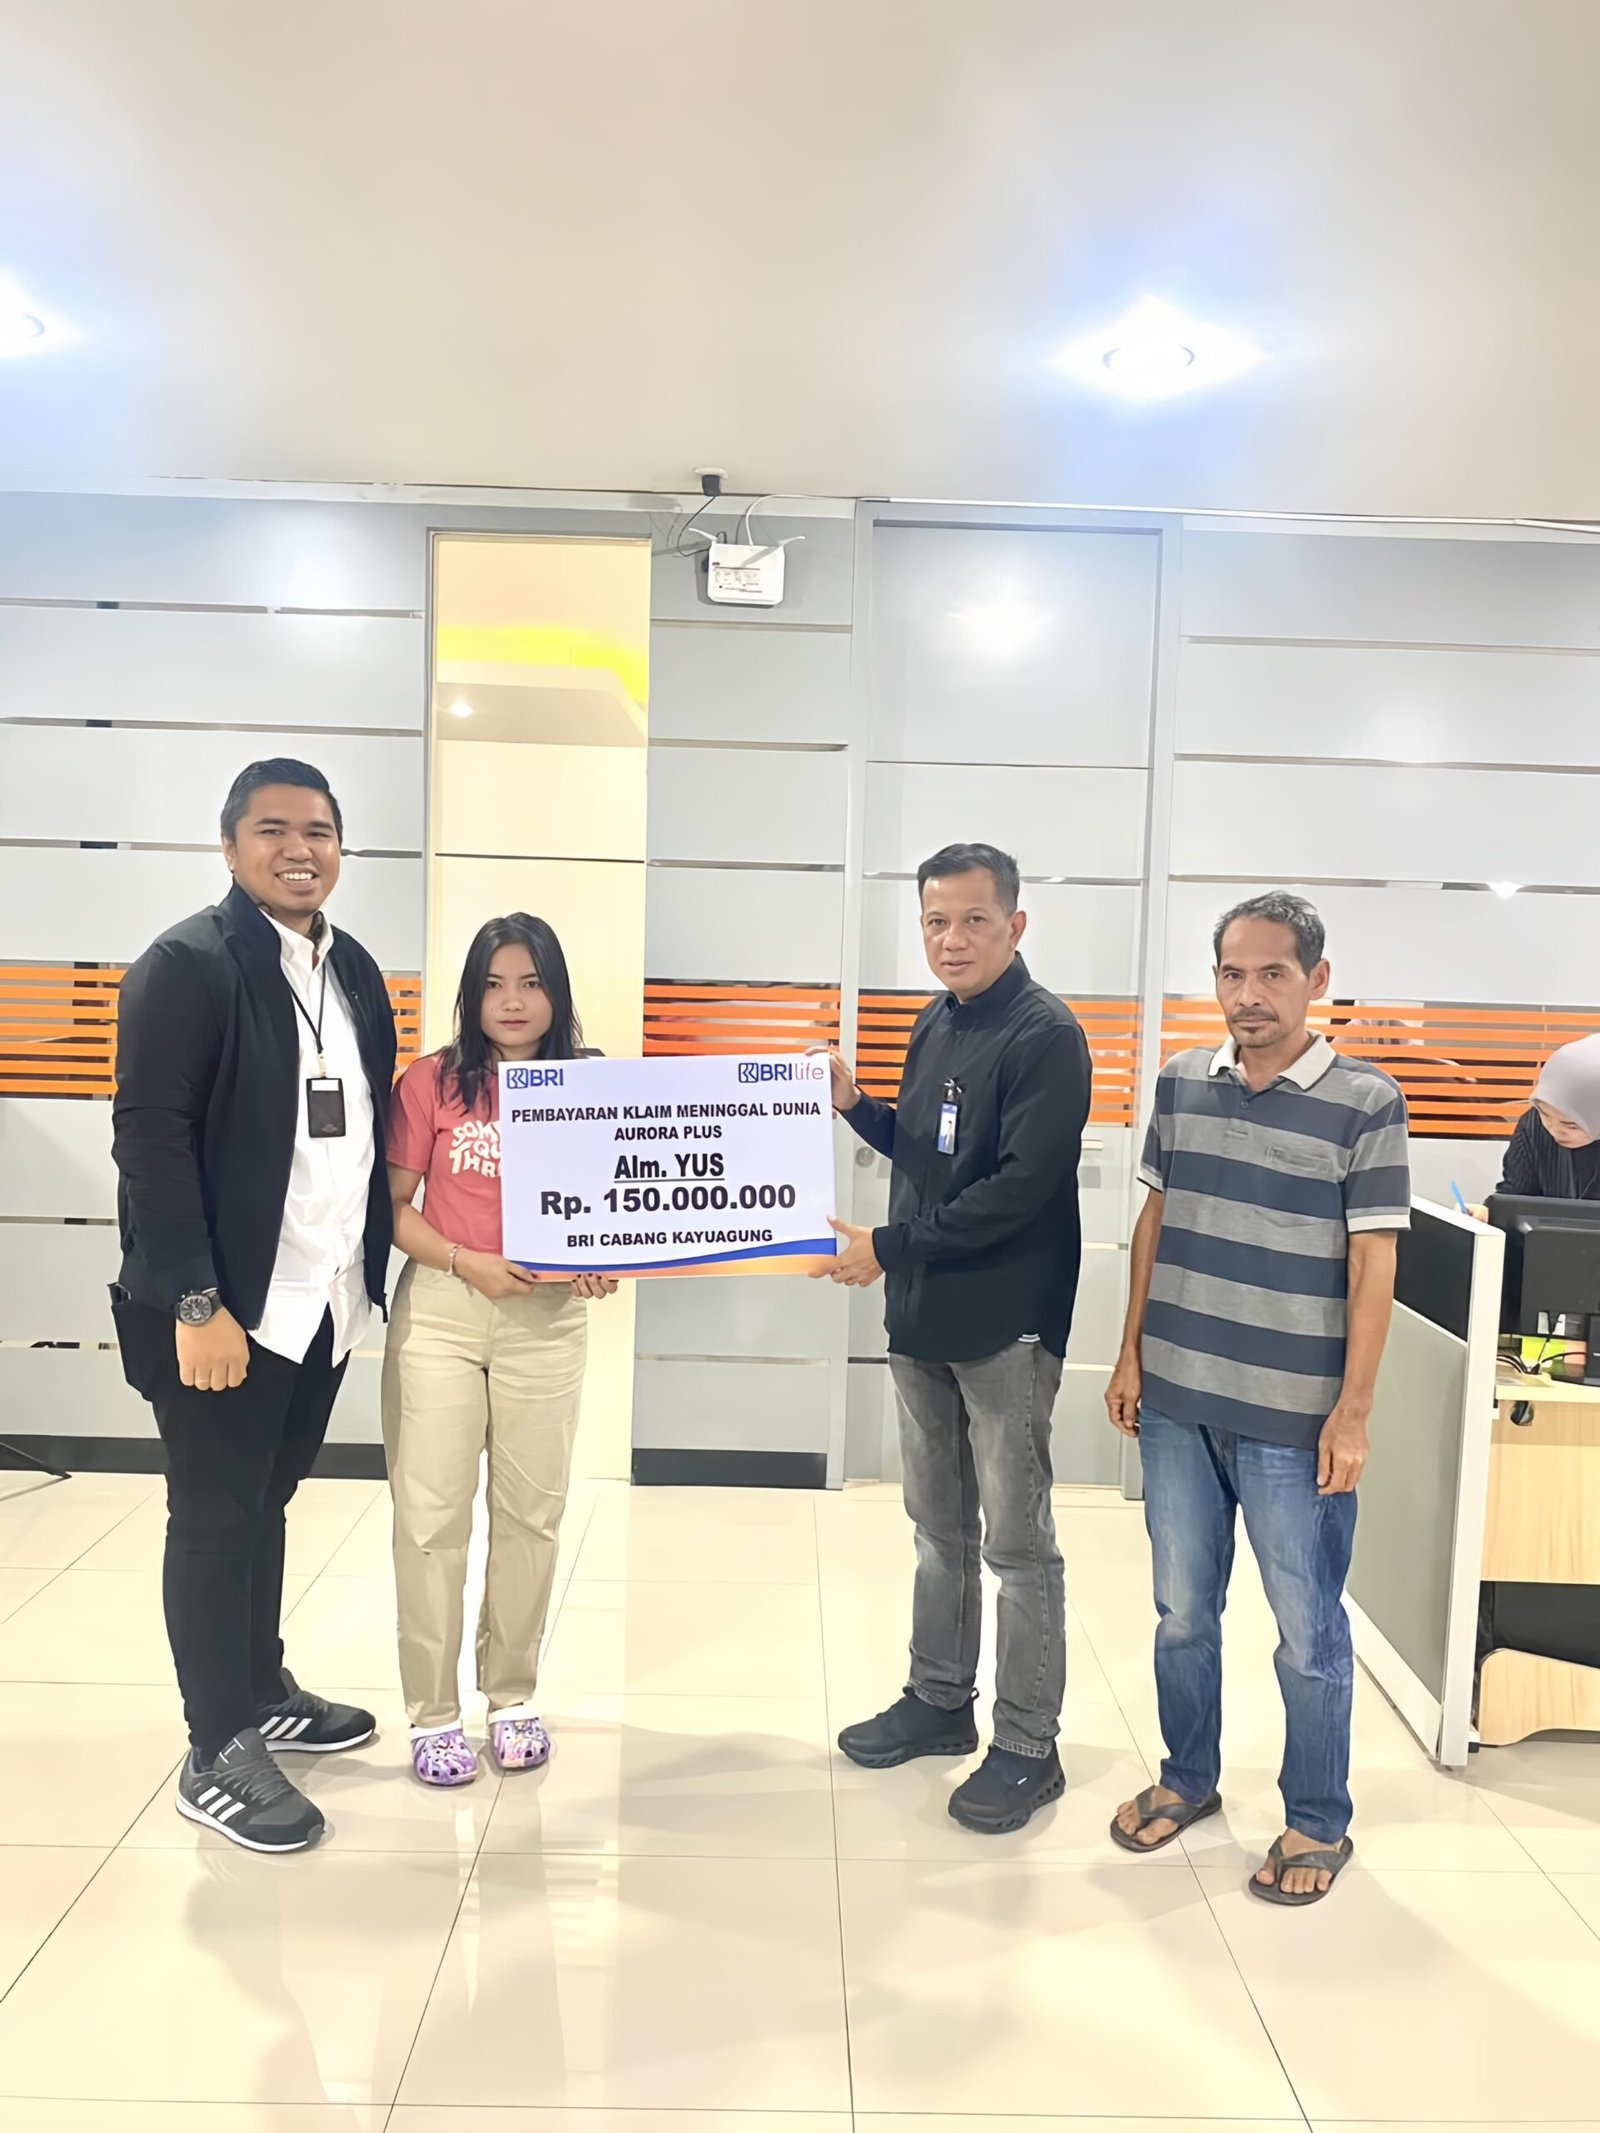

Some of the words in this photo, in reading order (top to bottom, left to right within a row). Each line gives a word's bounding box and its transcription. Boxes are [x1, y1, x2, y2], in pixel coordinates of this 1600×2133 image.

[529, 1068, 564, 1088] BRI
[511, 1106, 618, 1123] PEMBAYARAN
[623, 1105, 672, 1119] KLAIM
[677, 1102, 768, 1117] MENINGGAL
[772, 1101, 821, 1116] DUNIA
[614, 1126, 679, 1141] AURORA
[684, 1125, 722, 1139] PLUS
[449, 1141, 500, 1178] THR
[614, 1154, 667, 1179] Alm.
[674, 1152, 725, 1178] YUS
[540, 1191, 591, 1220] Rp.
[603, 1184, 796, 1213] 150.000.000
[567, 1234, 594, 1248] BRI
[599, 1232, 668, 1247] CABANG
[672, 1229, 773, 1245] KAYUAGUNG
